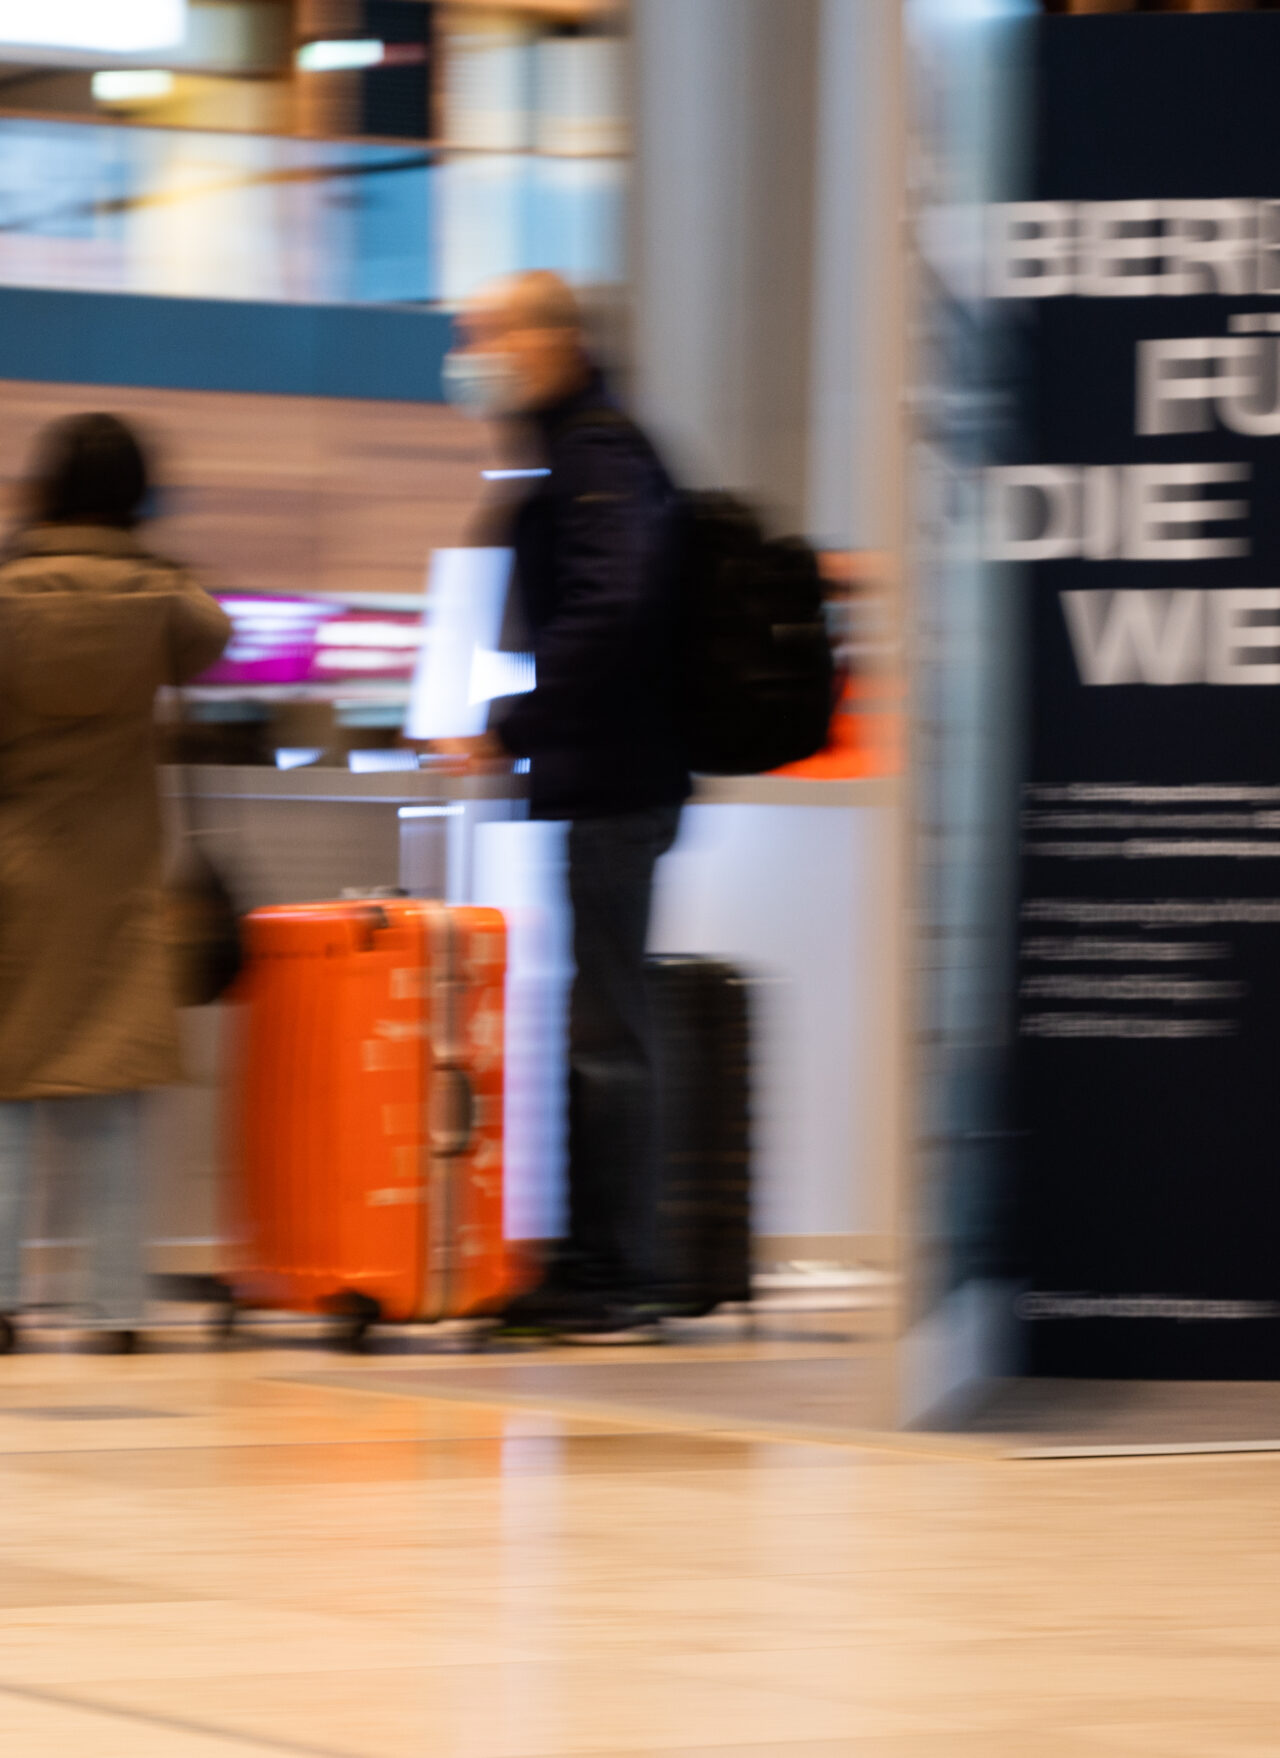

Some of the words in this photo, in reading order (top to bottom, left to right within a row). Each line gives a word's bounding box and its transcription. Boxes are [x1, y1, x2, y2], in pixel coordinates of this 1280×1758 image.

[984, 198, 1280, 298] BER
[982, 462, 1252, 561] DIE
[1060, 588, 1280, 685] WE
